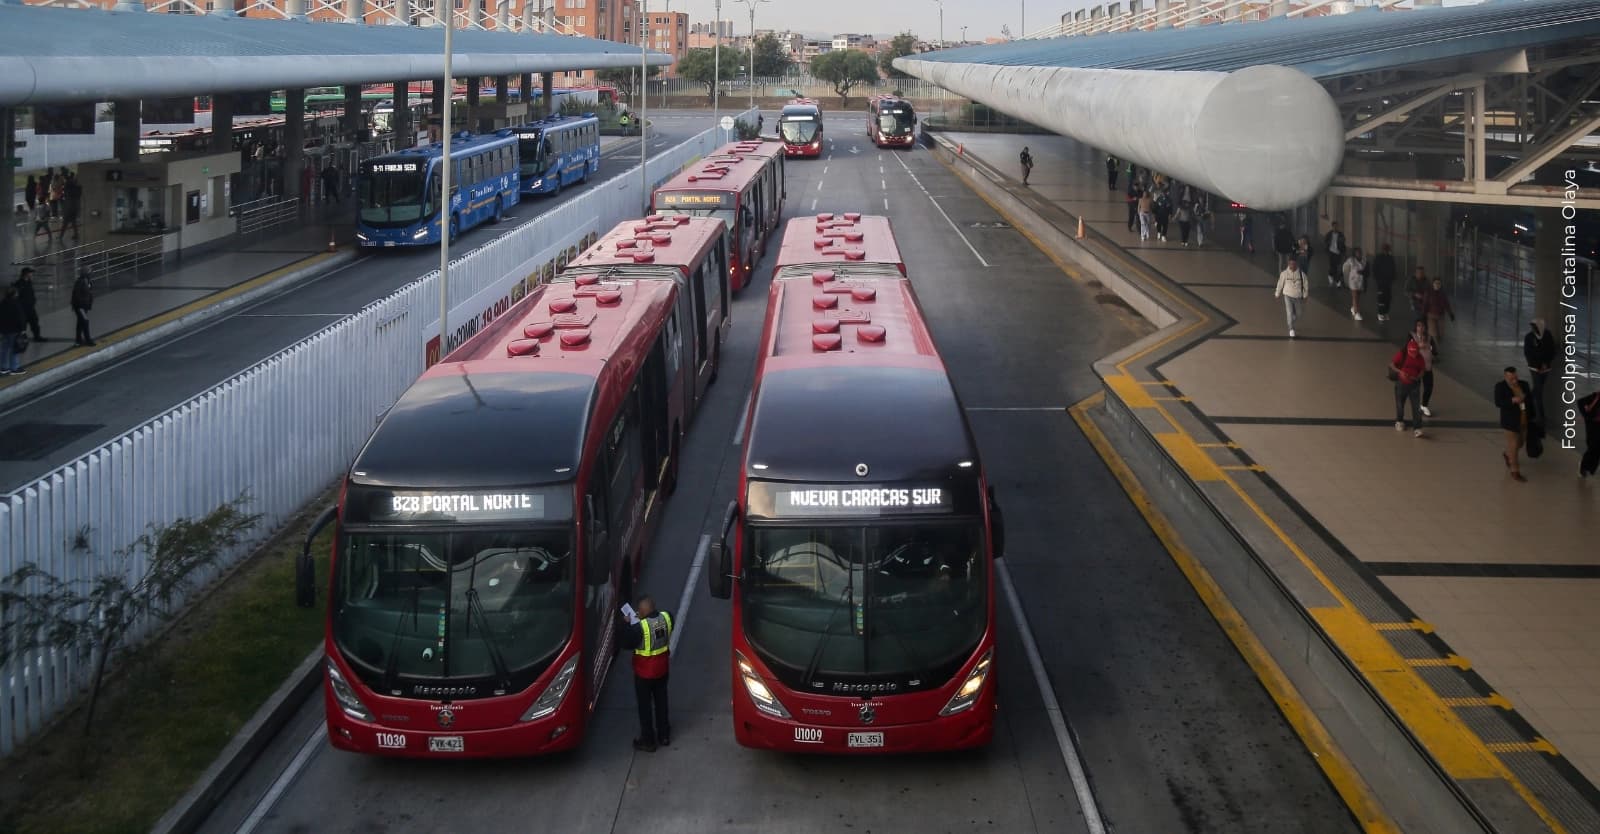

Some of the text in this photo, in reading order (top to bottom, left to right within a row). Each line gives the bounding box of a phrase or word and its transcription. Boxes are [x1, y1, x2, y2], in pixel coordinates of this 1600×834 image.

[703, 195, 721, 203] NORTE
[392, 493, 531, 512] B28 PORTAL NORTE
[790, 488, 942, 506] NUEVA CARACAS SUR
[414, 685, 477, 695] Marcopolo
[832, 682, 897, 692] Marcopolo
[375, 732, 406, 746] T1030
[794, 727, 823, 741] U1009
